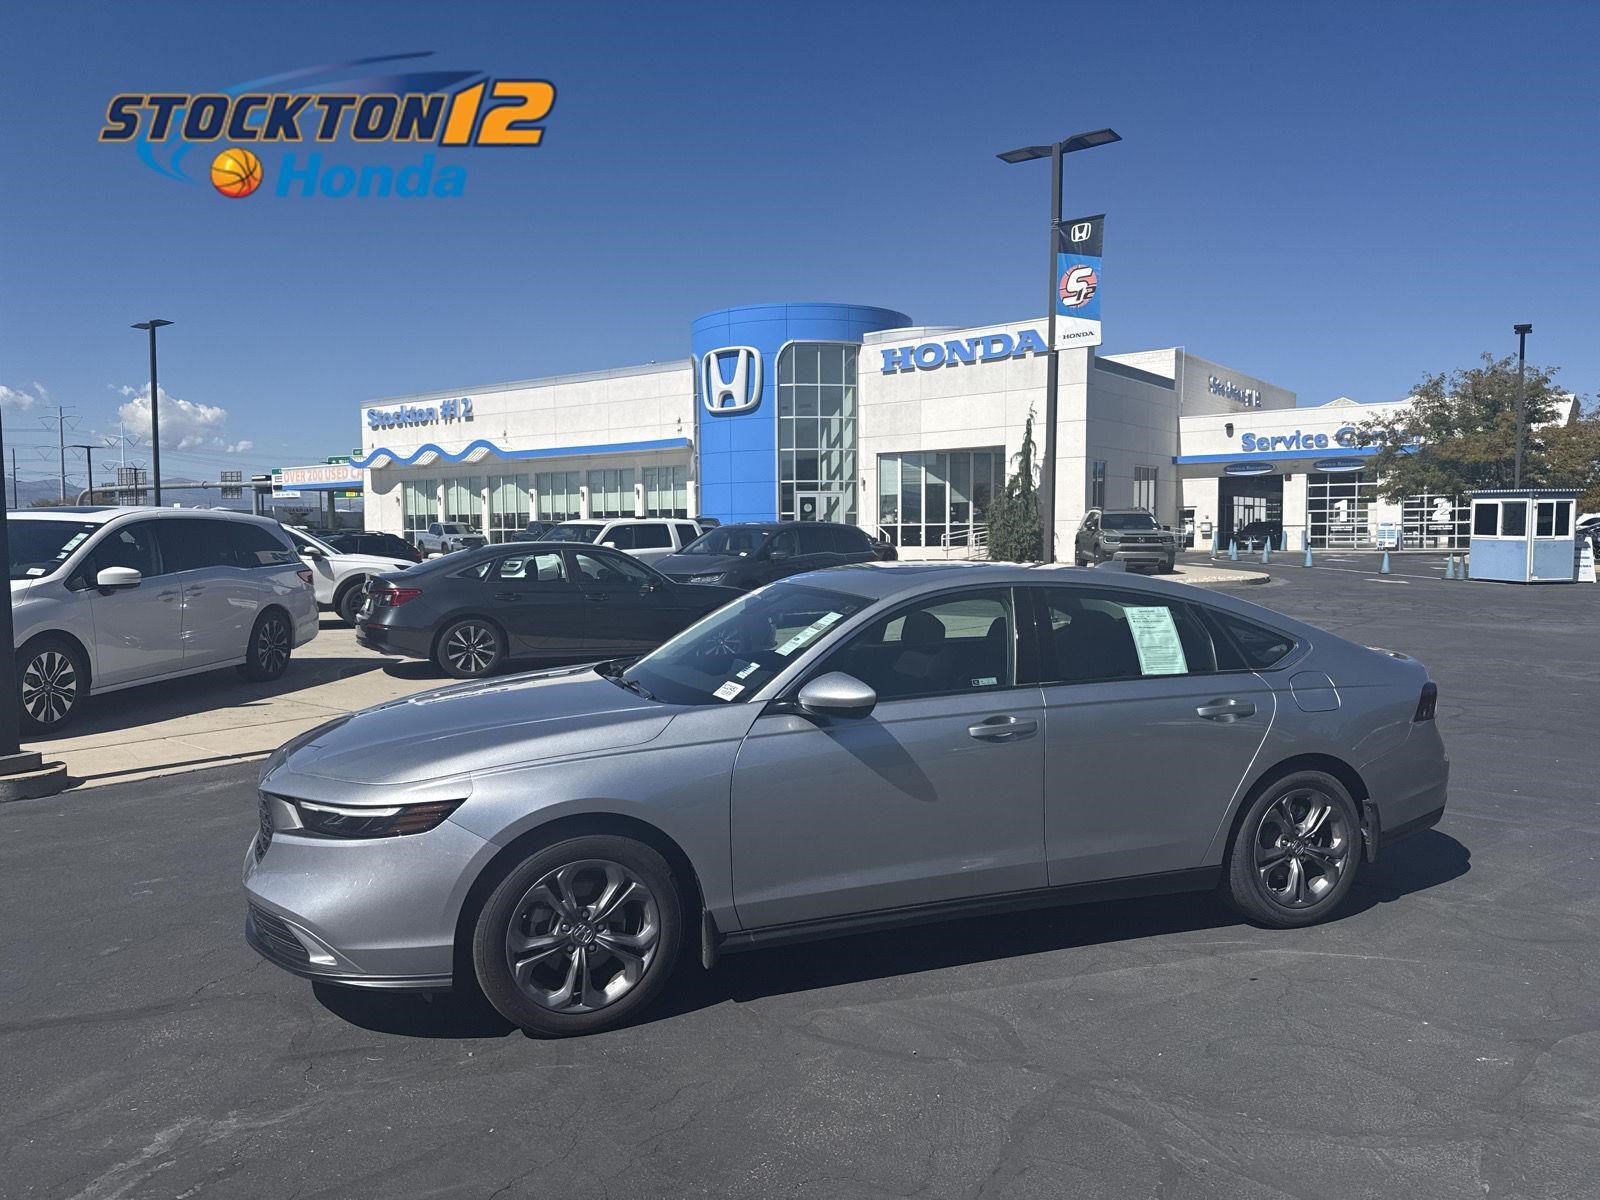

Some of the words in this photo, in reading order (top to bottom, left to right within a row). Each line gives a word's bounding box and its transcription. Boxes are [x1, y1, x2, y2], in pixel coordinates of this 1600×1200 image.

[1063, 331, 1095, 340] HONDA
[881, 329, 1049, 374] HONDA
[367, 404, 437, 428] Stockton
[440, 398, 474, 421] #12
[1242, 430, 1329, 452] Service
[283, 471, 305, 483] OVER
[308, 470, 321, 482] 200
[325, 468, 348, 480] USED
[1334, 499, 1347, 521] 1
